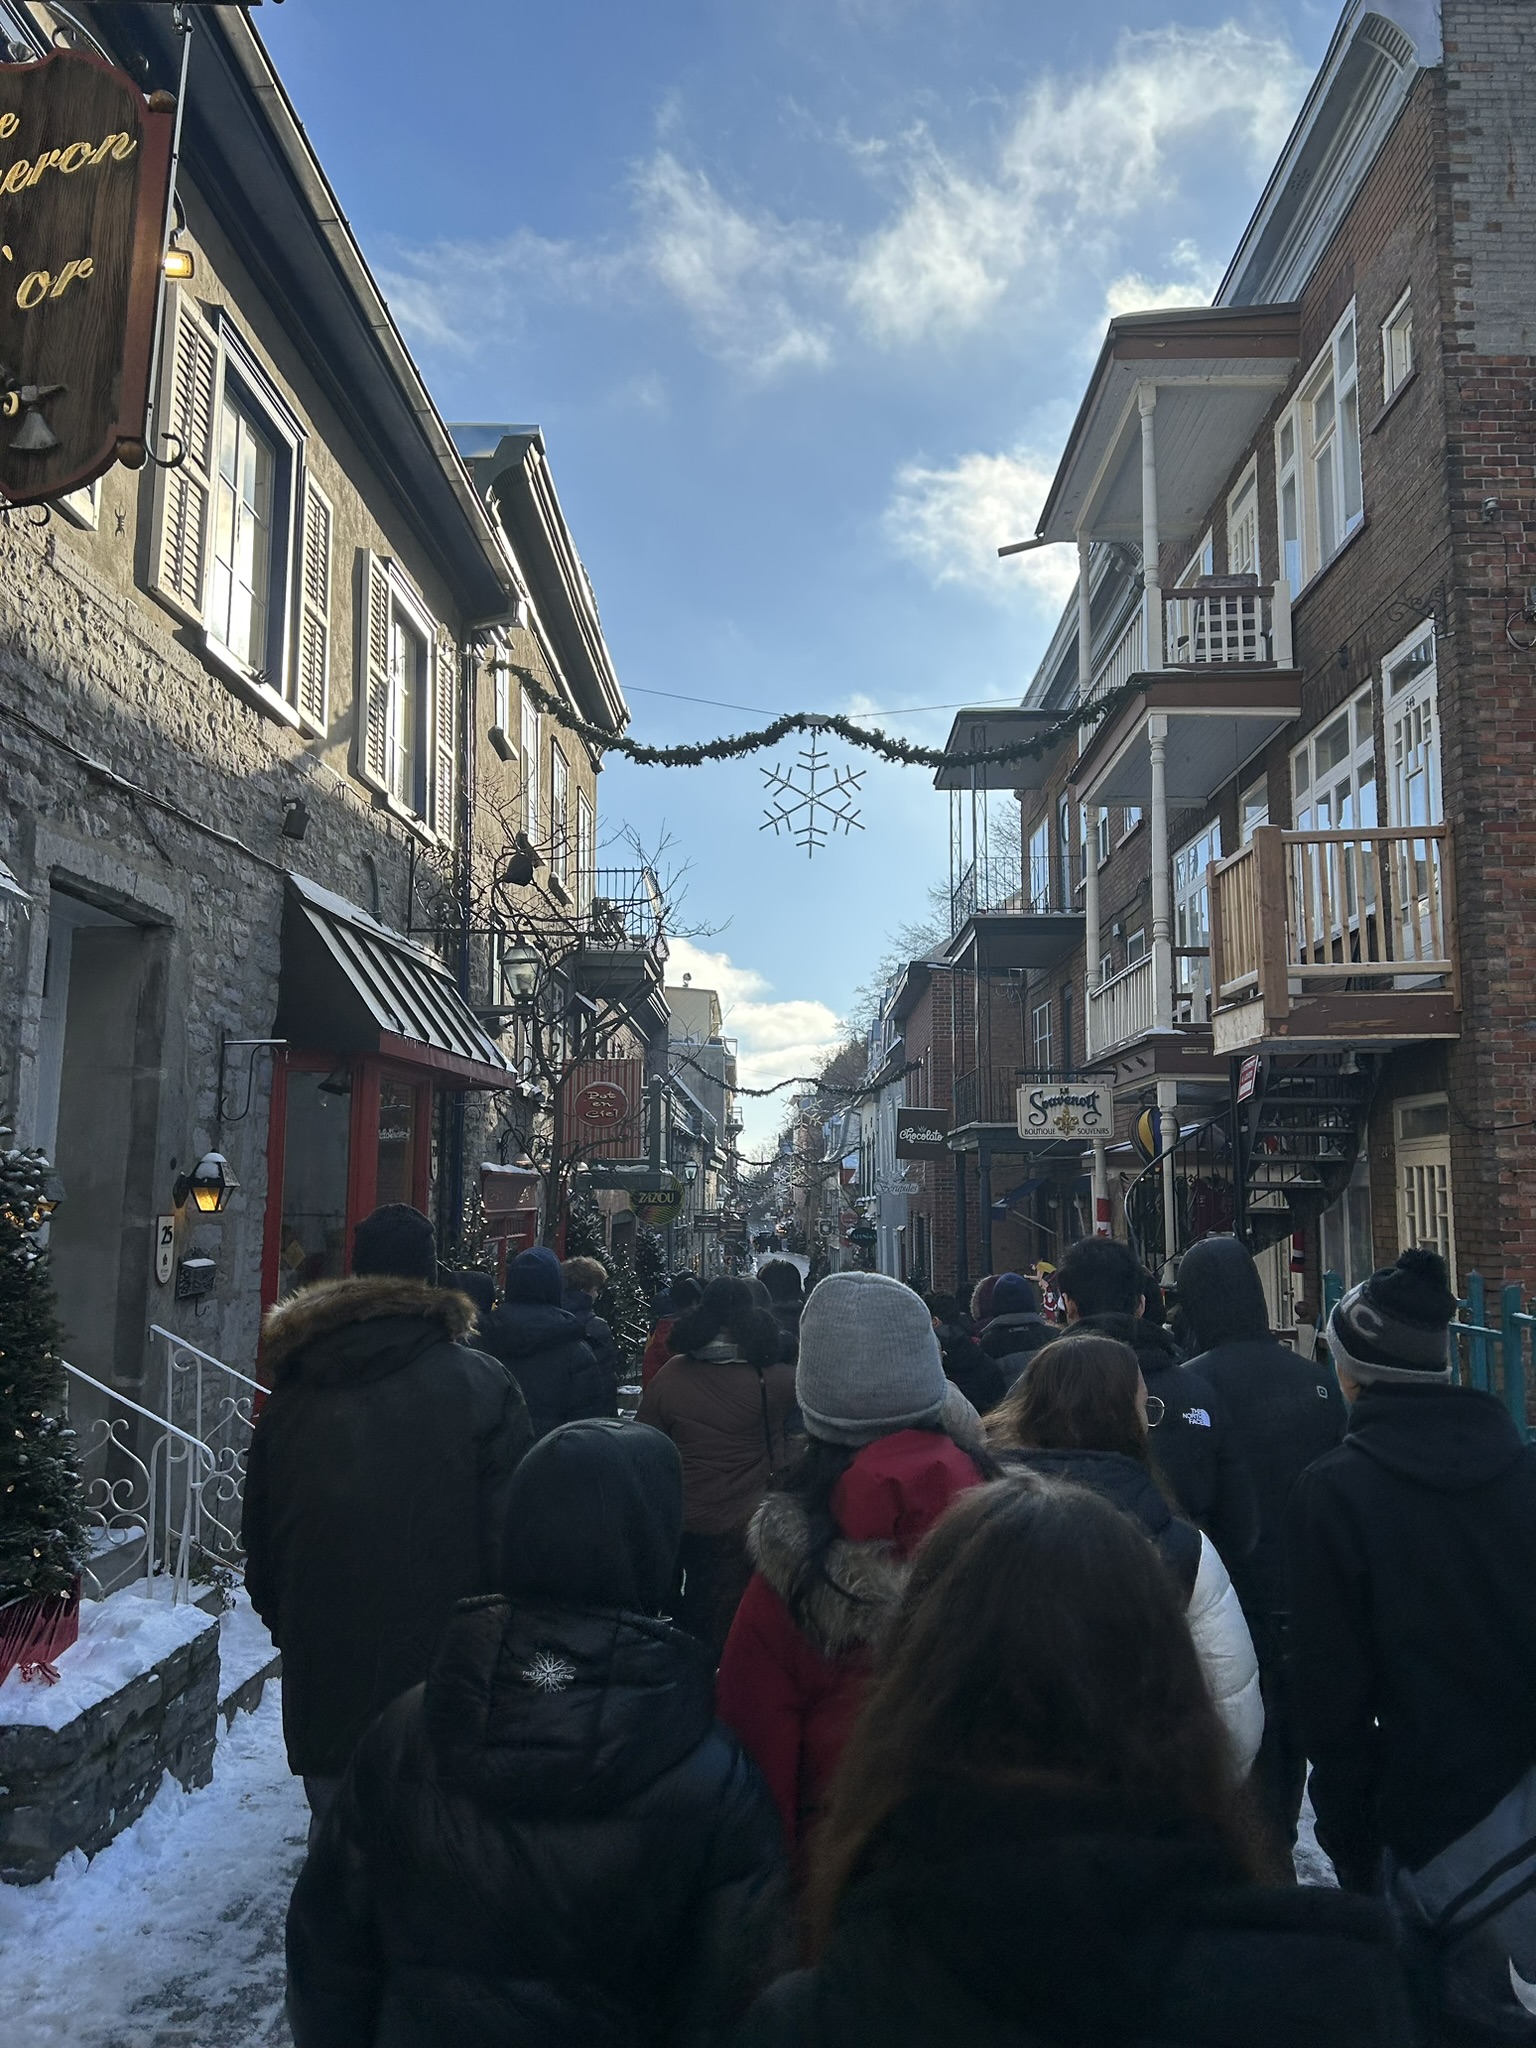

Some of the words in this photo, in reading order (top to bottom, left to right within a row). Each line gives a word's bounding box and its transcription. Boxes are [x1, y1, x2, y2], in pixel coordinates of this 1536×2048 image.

[0, 131, 138, 196] eron
[1024, 1127, 1056, 1135] BOUTIQUE
[1077, 1127, 1110, 1135] SOUVENIRS
[638, 1192, 675, 1204] ZAZOU
[161, 1225, 173, 1246] 25
